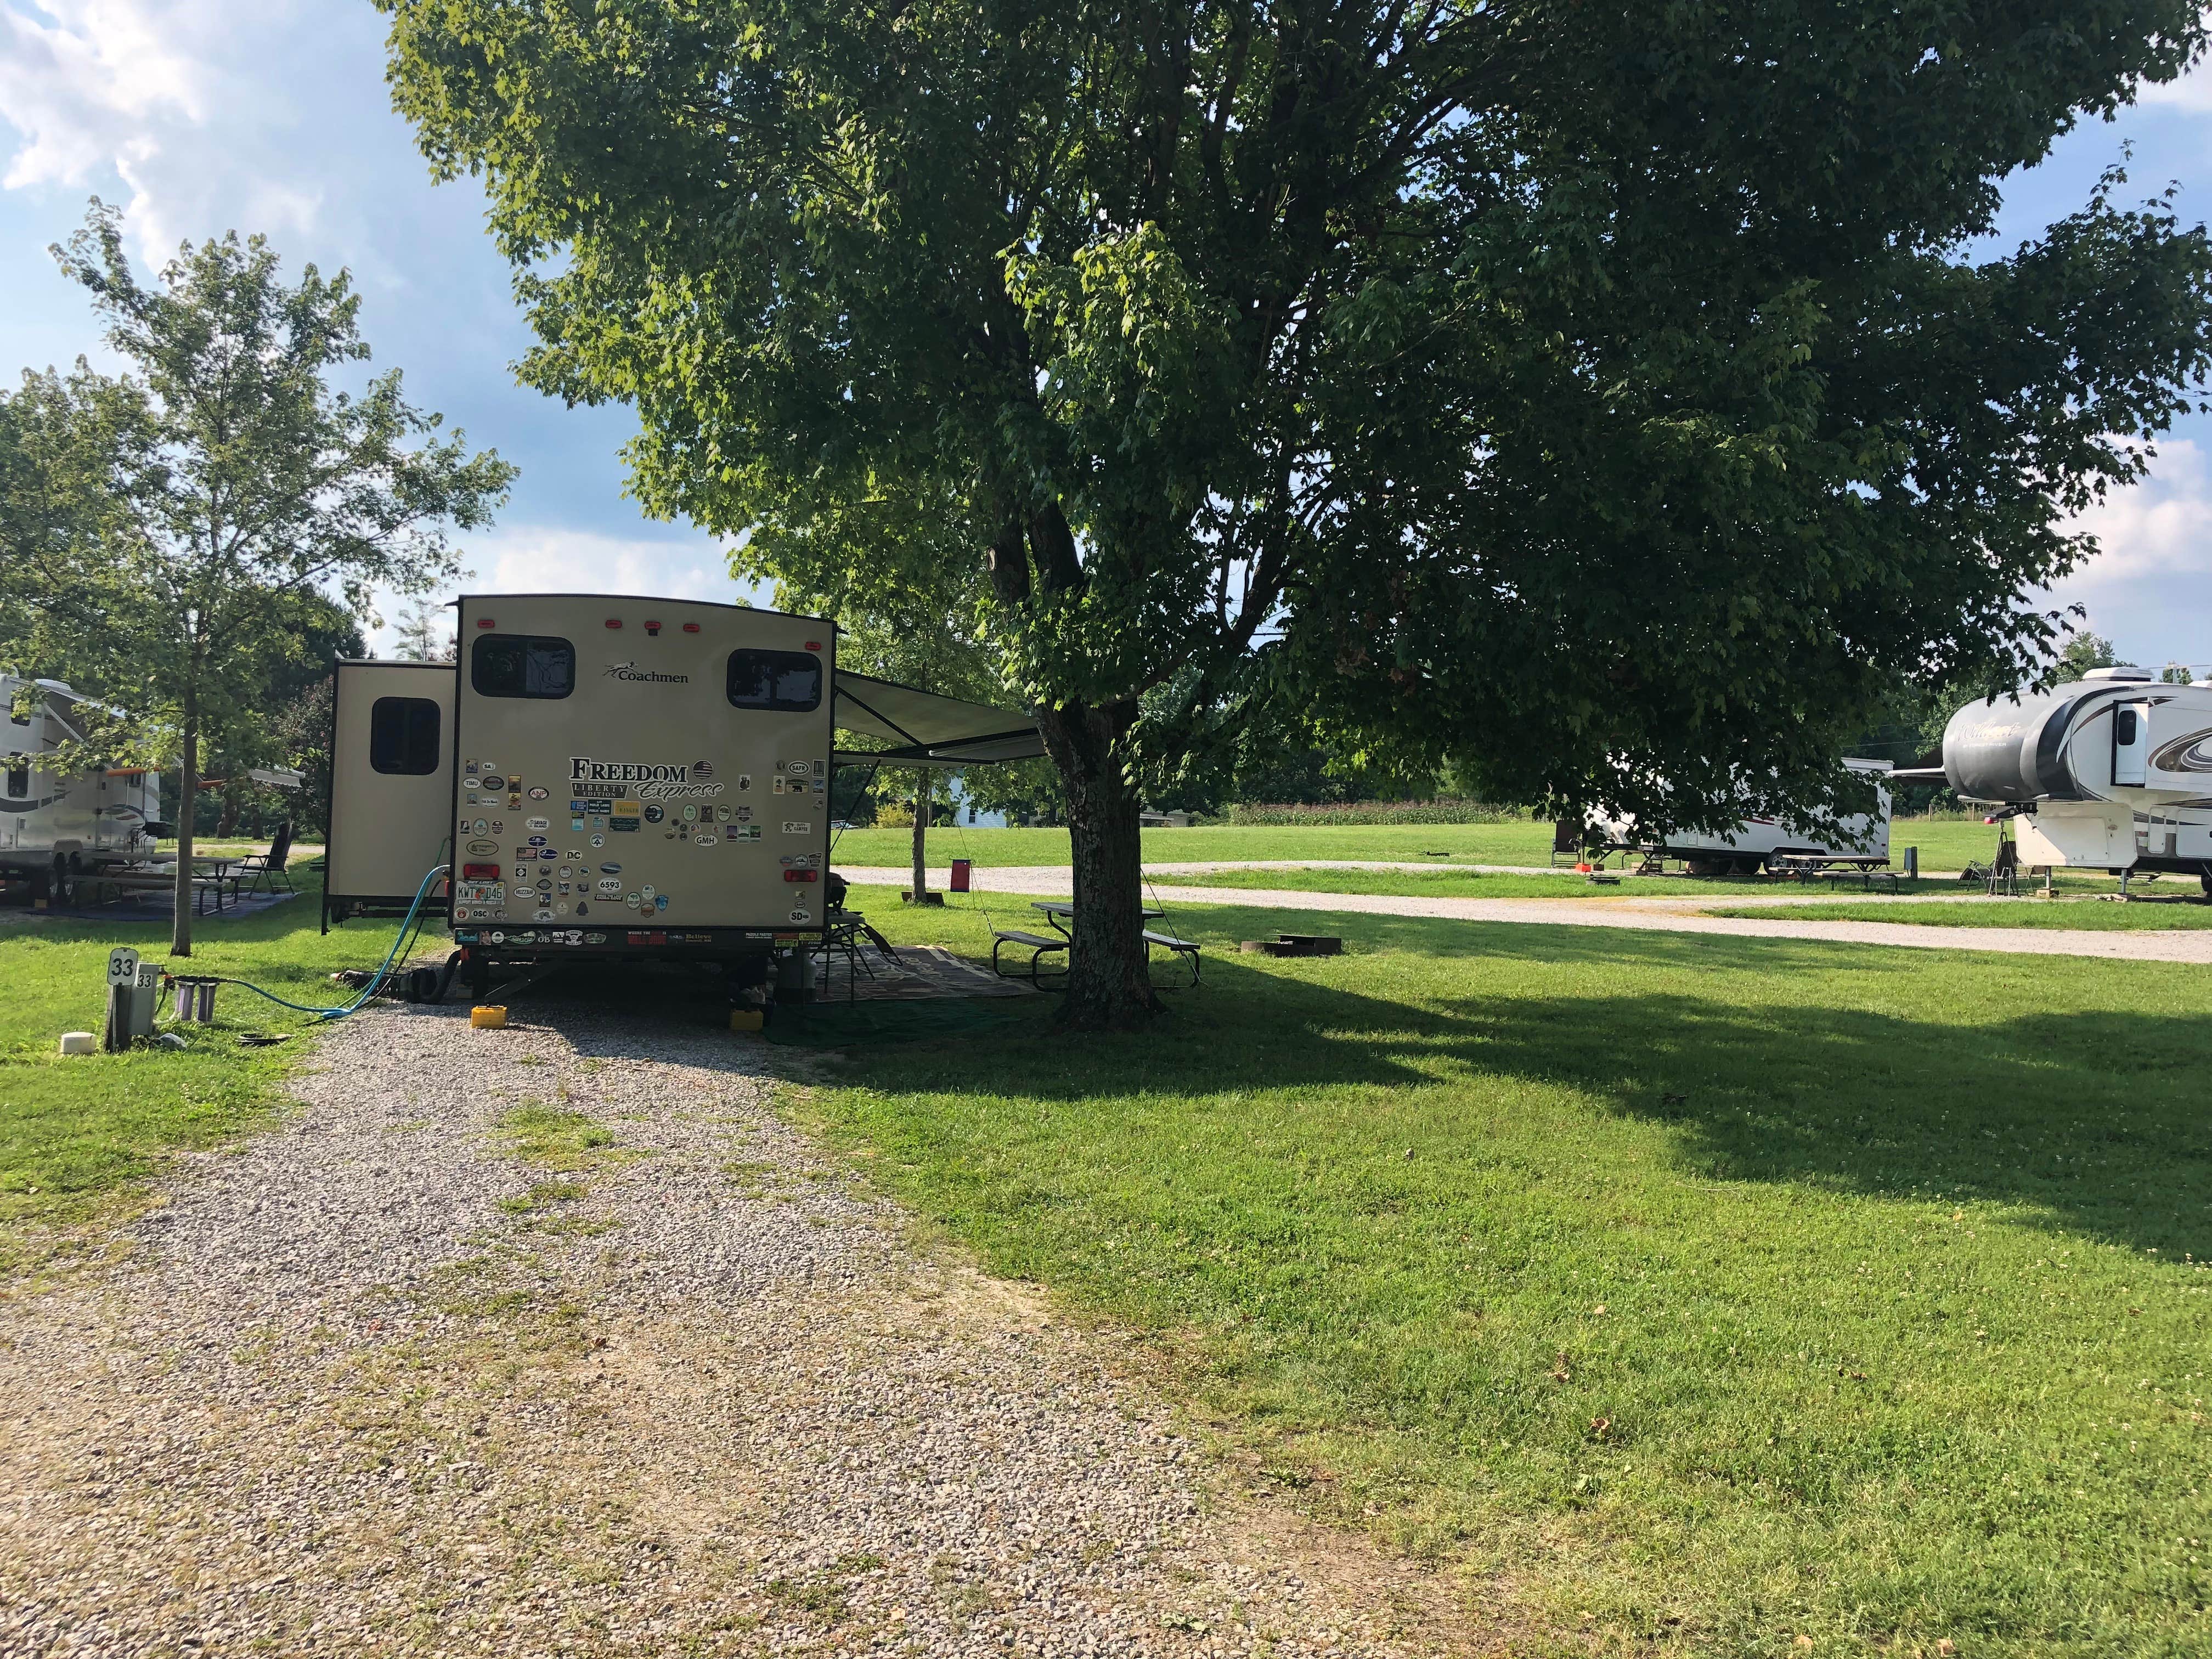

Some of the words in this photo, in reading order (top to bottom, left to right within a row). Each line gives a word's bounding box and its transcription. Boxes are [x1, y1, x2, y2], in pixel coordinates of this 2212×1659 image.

[618, 670, 689, 684] Coachmen
[570, 758, 687, 783] FREEDOM
[574, 783, 626, 792] LIBERTY
[634, 781, 724, 800] Express
[458, 887, 476, 898] KWT
[486, 887, 502, 899] D46
[791, 912, 803, 921] SD
[111, 958, 134, 977] 33
[137, 974, 151, 988] 33
